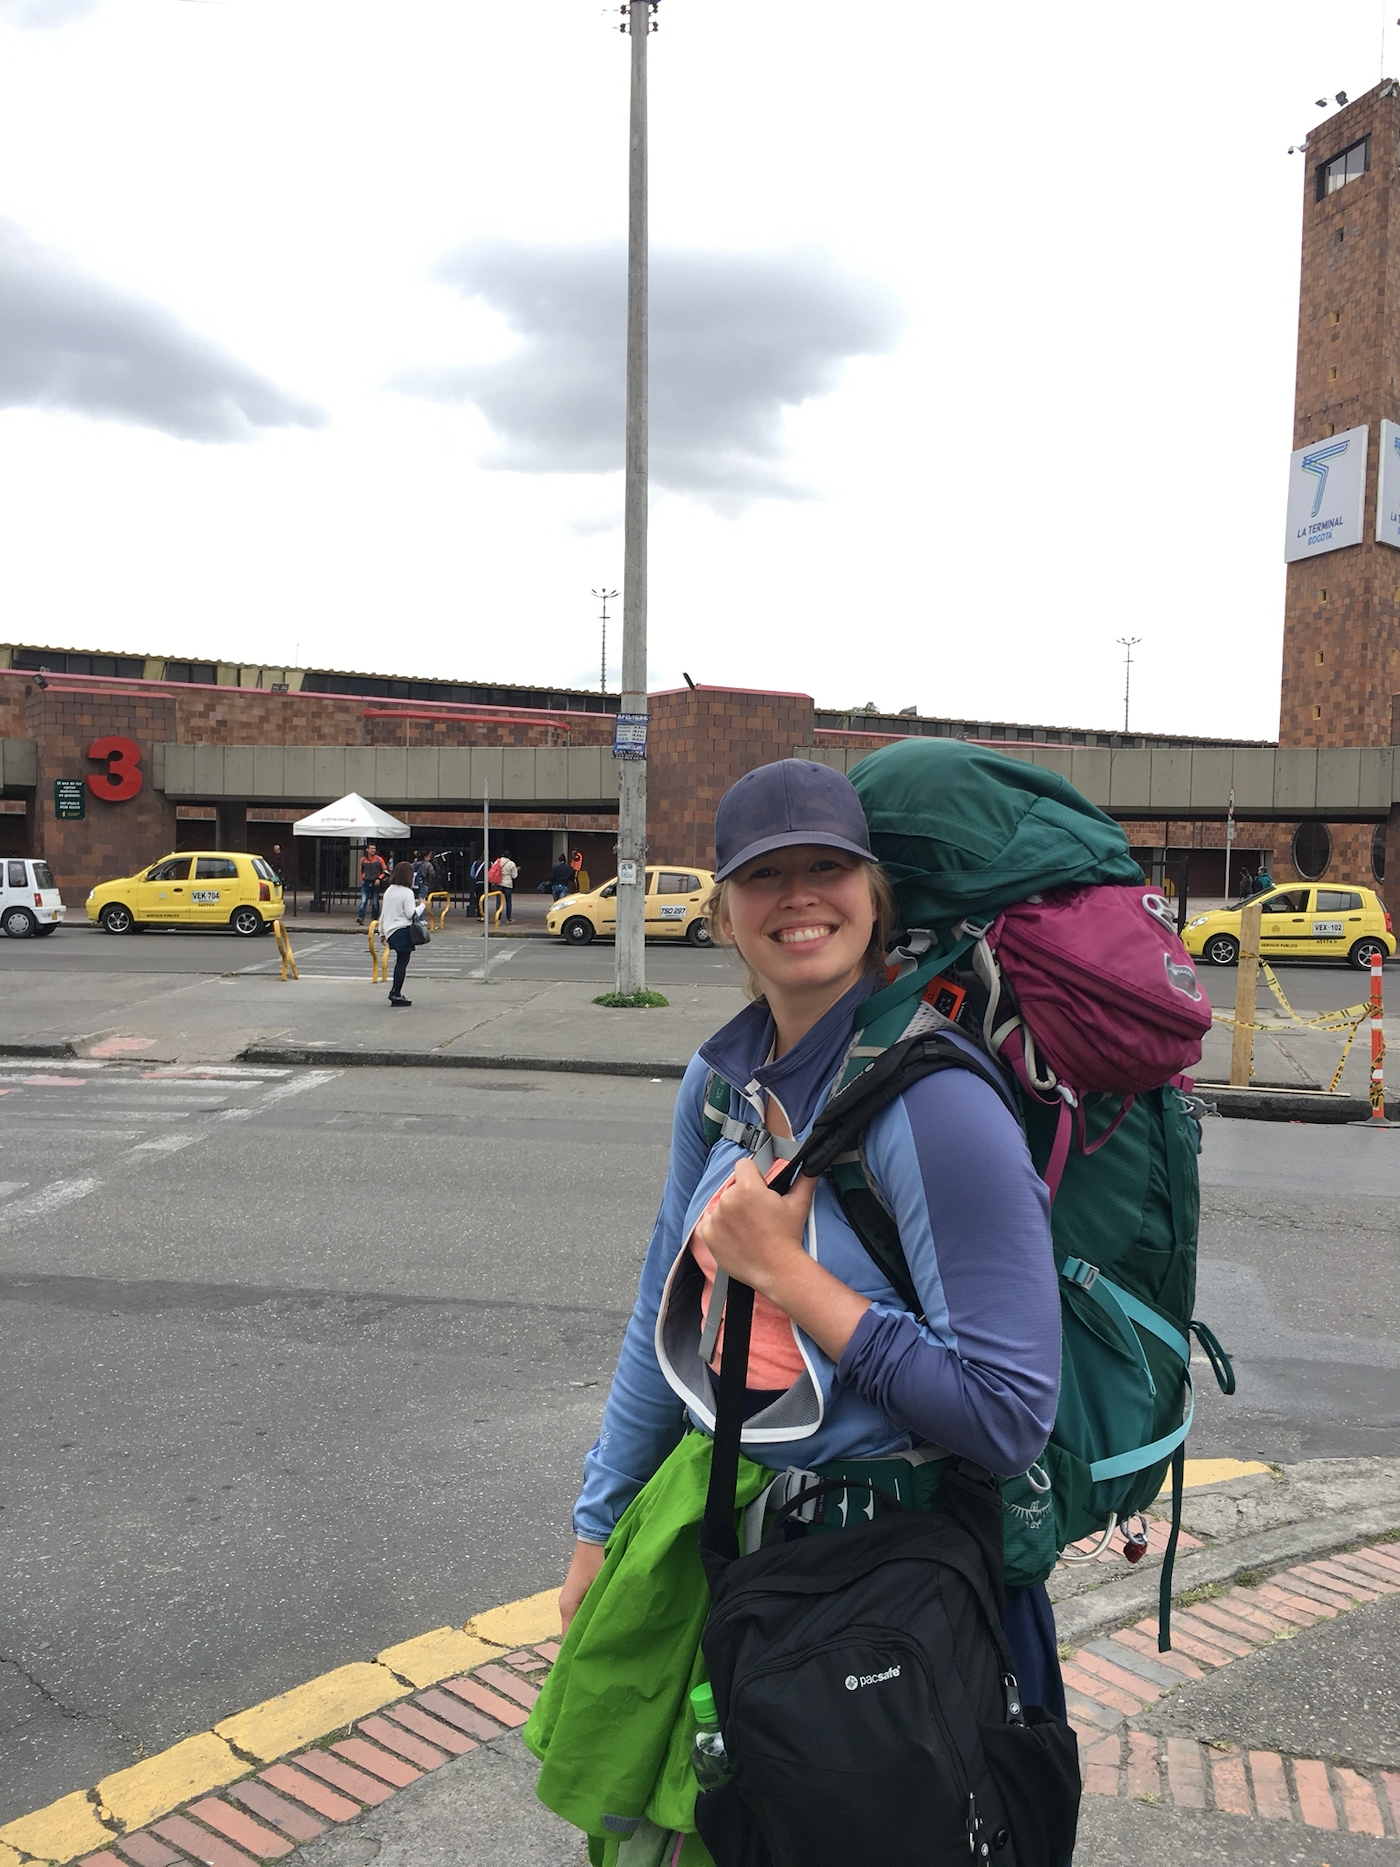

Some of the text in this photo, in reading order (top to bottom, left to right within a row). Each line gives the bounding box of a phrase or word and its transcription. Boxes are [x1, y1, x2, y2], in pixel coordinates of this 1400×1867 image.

[1297, 515, 1344, 539] LA TERMINAL
[1307, 529, 1333, 546] BOGOTÁ
[86, 735, 144, 802] 3
[860, 1666, 901, 1688] pacsafe
